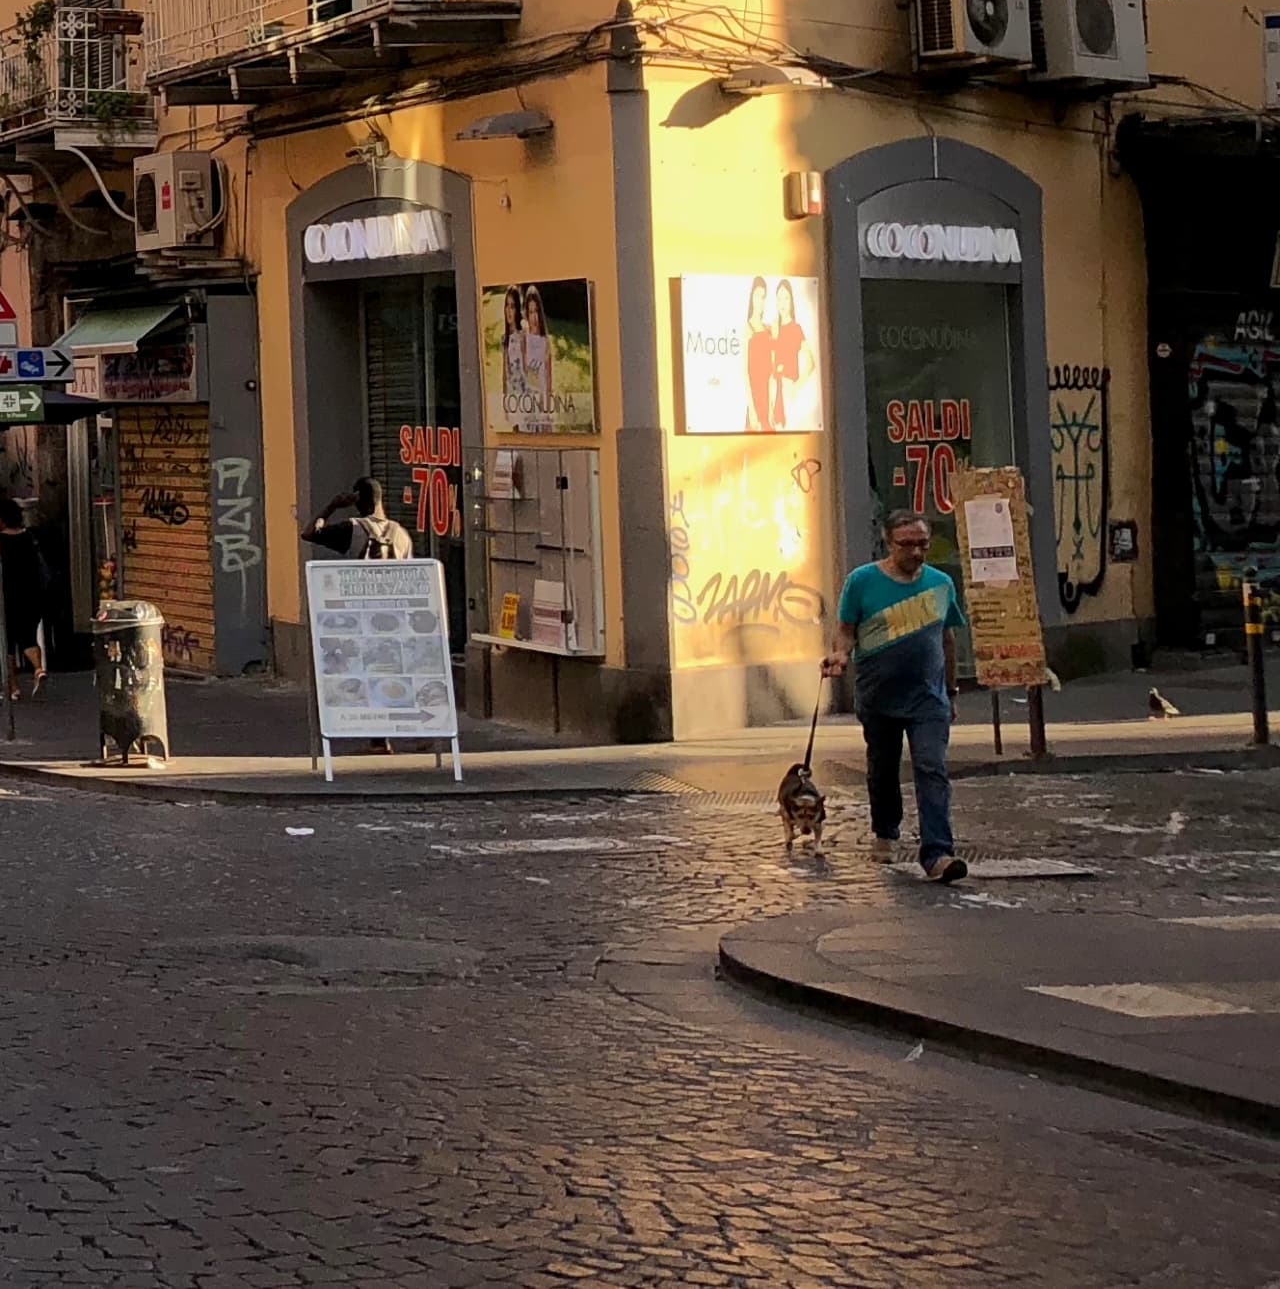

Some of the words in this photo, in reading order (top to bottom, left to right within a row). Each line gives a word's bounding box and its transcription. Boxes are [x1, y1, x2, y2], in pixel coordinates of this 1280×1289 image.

[866, 222, 1022, 263] COCONUDINA
[886, 398, 972, 444] SALDI
[399, 424, 460, 467] SALDI
